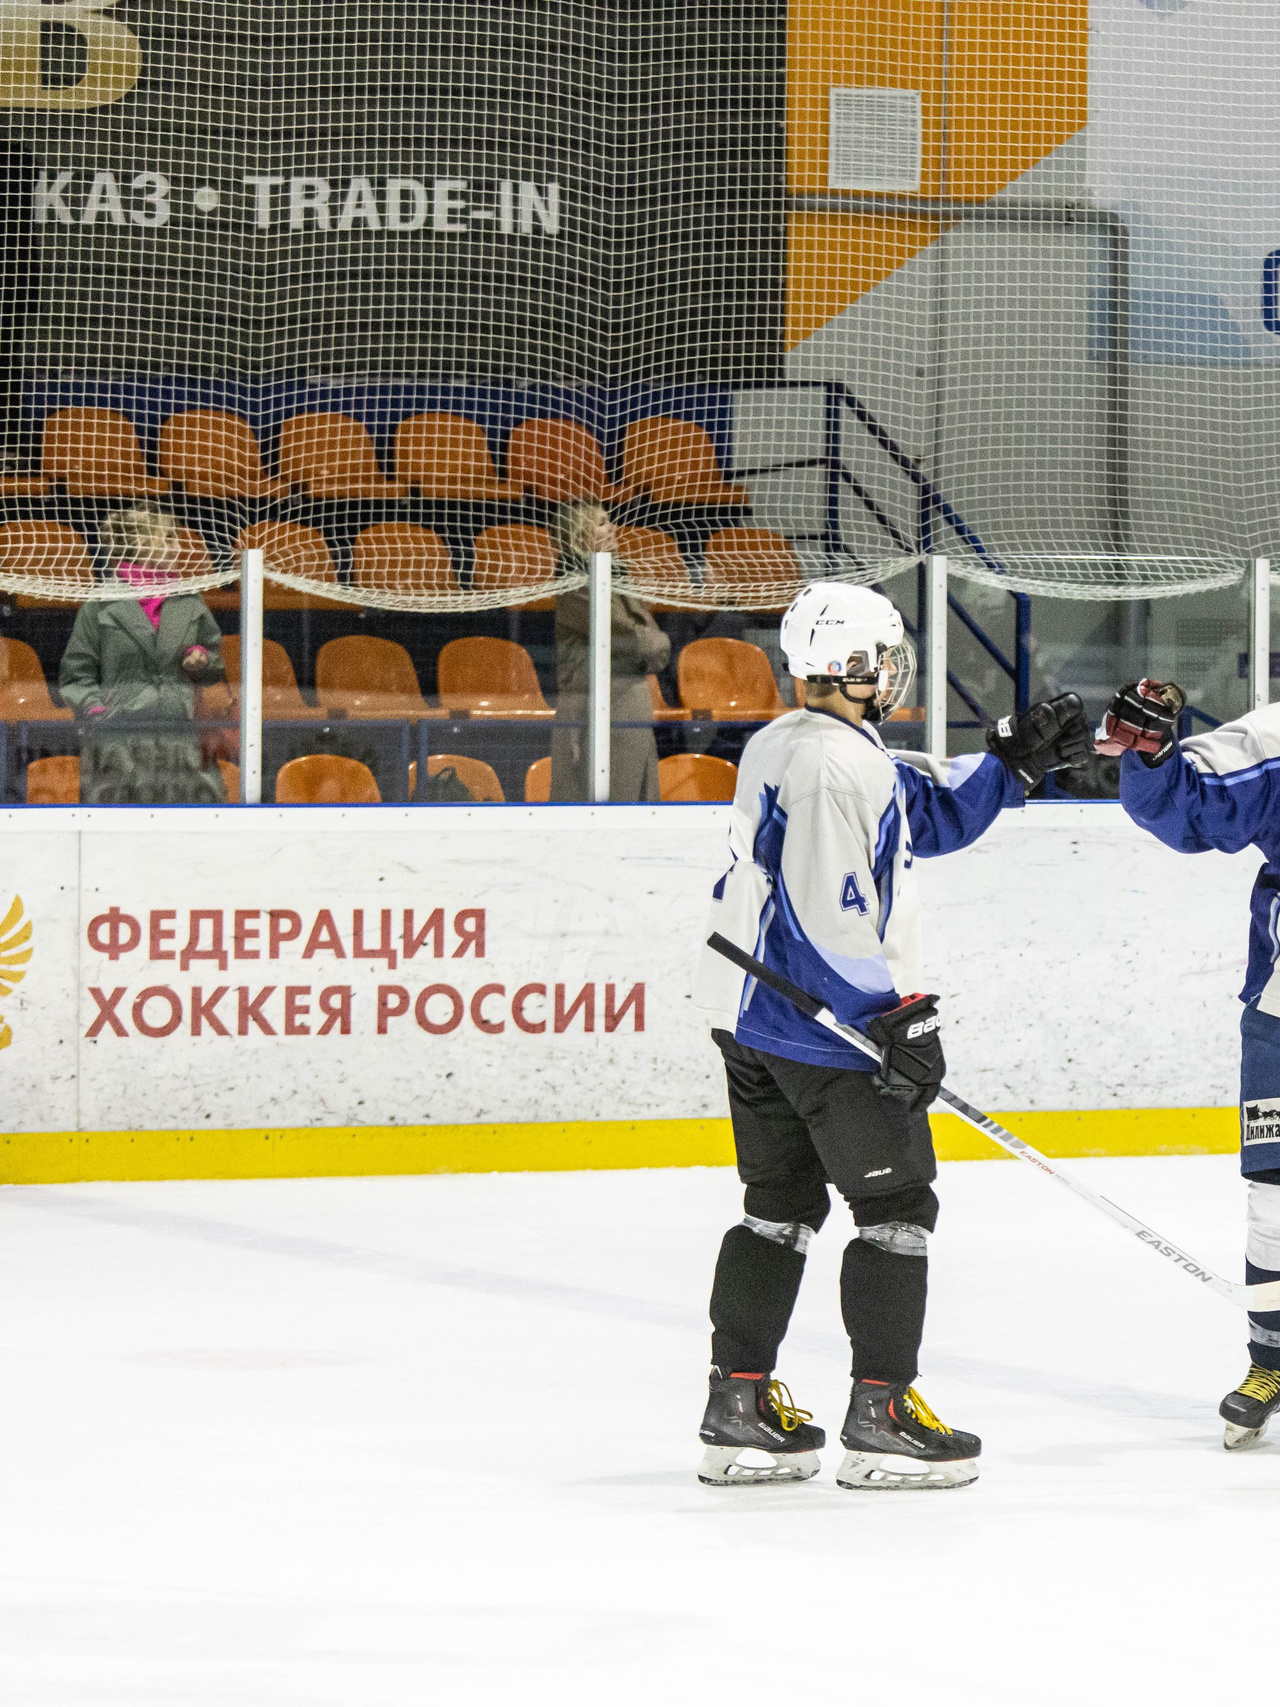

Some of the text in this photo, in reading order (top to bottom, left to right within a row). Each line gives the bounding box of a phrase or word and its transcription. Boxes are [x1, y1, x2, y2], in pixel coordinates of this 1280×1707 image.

[244, 175, 561, 236] TRADE-IN
[839, 871, 870, 916] 4
[86, 907, 487, 970] ФЕДЕРАЦИЯ
[84, 982, 646, 1038] ХОККЕЯ РОССИИ
[1020, 1150, 1055, 1175] EASTON
[1134, 1229, 1213, 1283] EASTON
